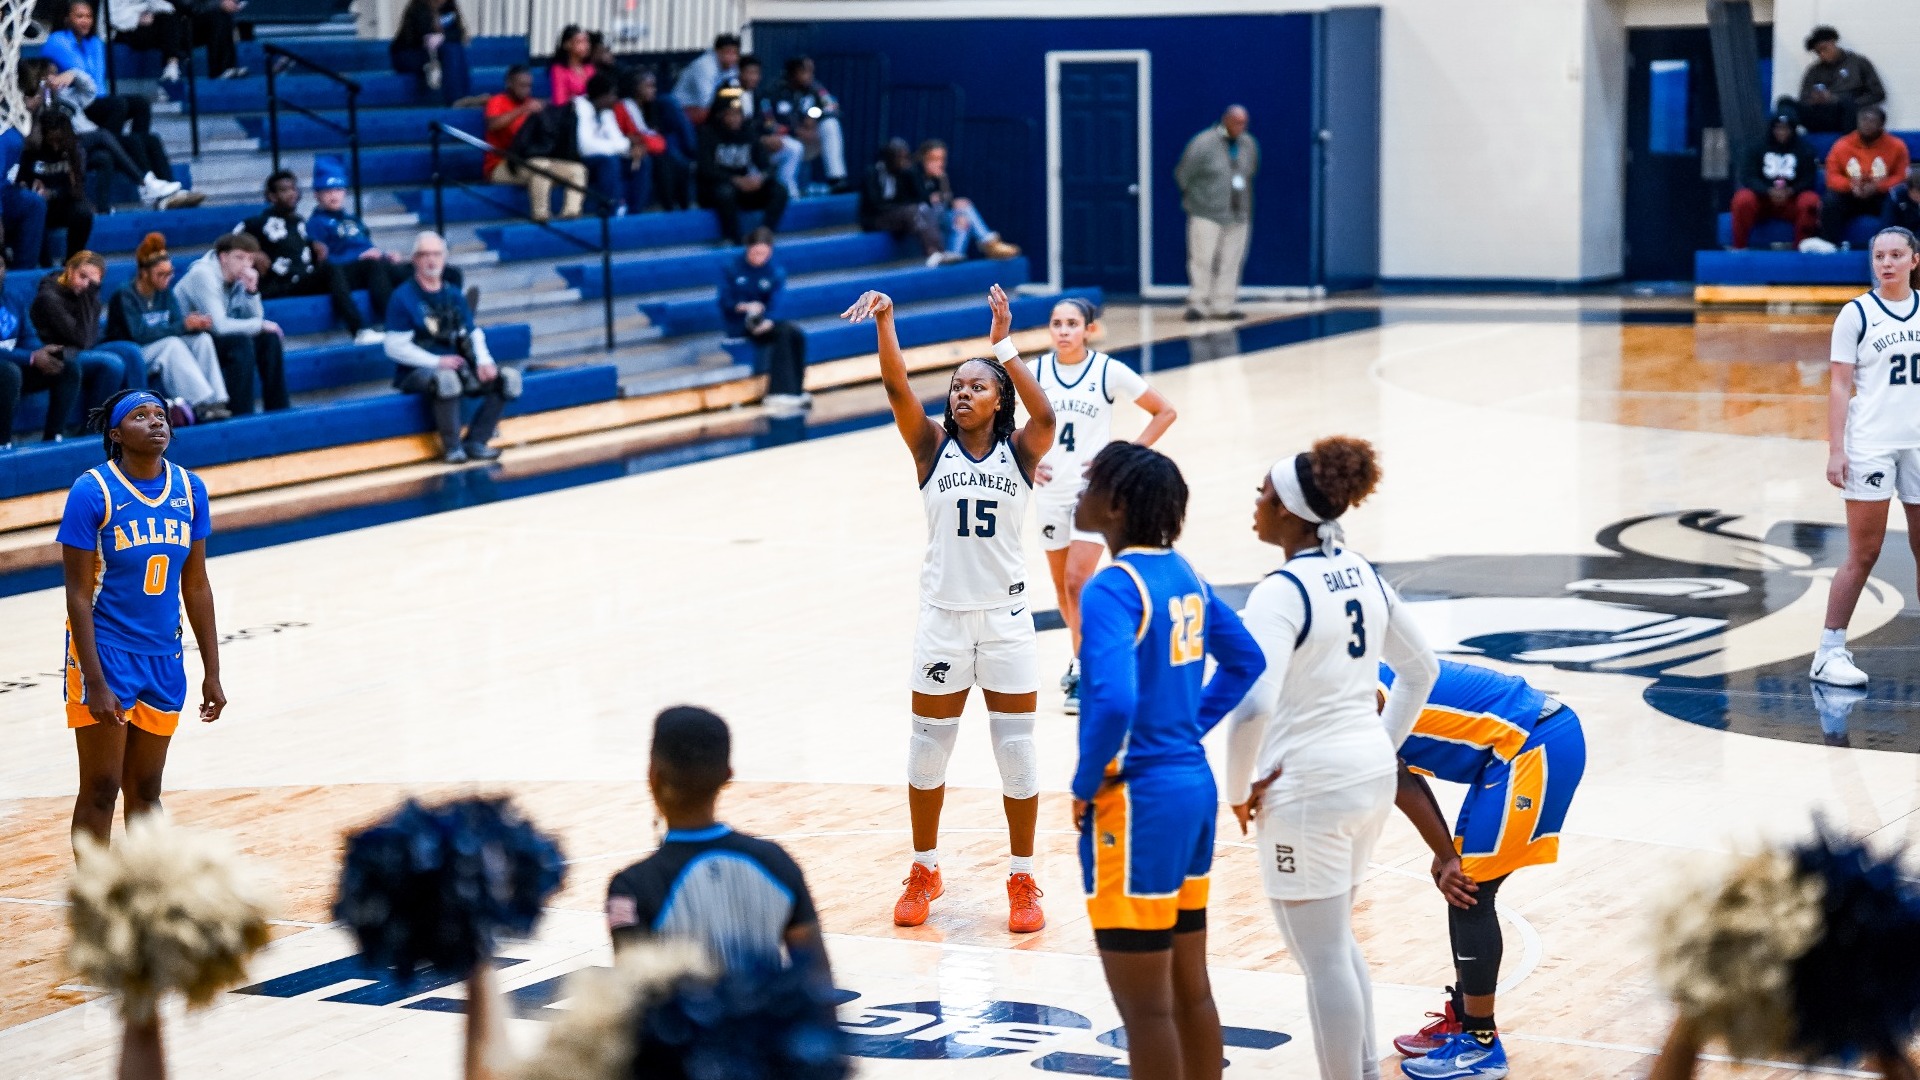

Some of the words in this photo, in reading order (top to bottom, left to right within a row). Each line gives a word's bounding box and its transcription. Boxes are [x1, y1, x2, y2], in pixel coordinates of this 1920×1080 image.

[1872, 329, 1920, 353] BUCCANE
[1053, 399, 1100, 419] CANEERS
[1059, 422, 1075, 452] 4
[937, 472, 1018, 497] BUCCANEERS
[957, 498, 998, 538] 15
[114, 517, 191, 551] ALLEN
[143, 554, 170, 595] 0
[1323, 567, 1365, 593] BAILEY
[1168, 592, 1204, 667] 22
[1345, 598, 1366, 659] 3
[1275, 843, 1296, 874] CSU
